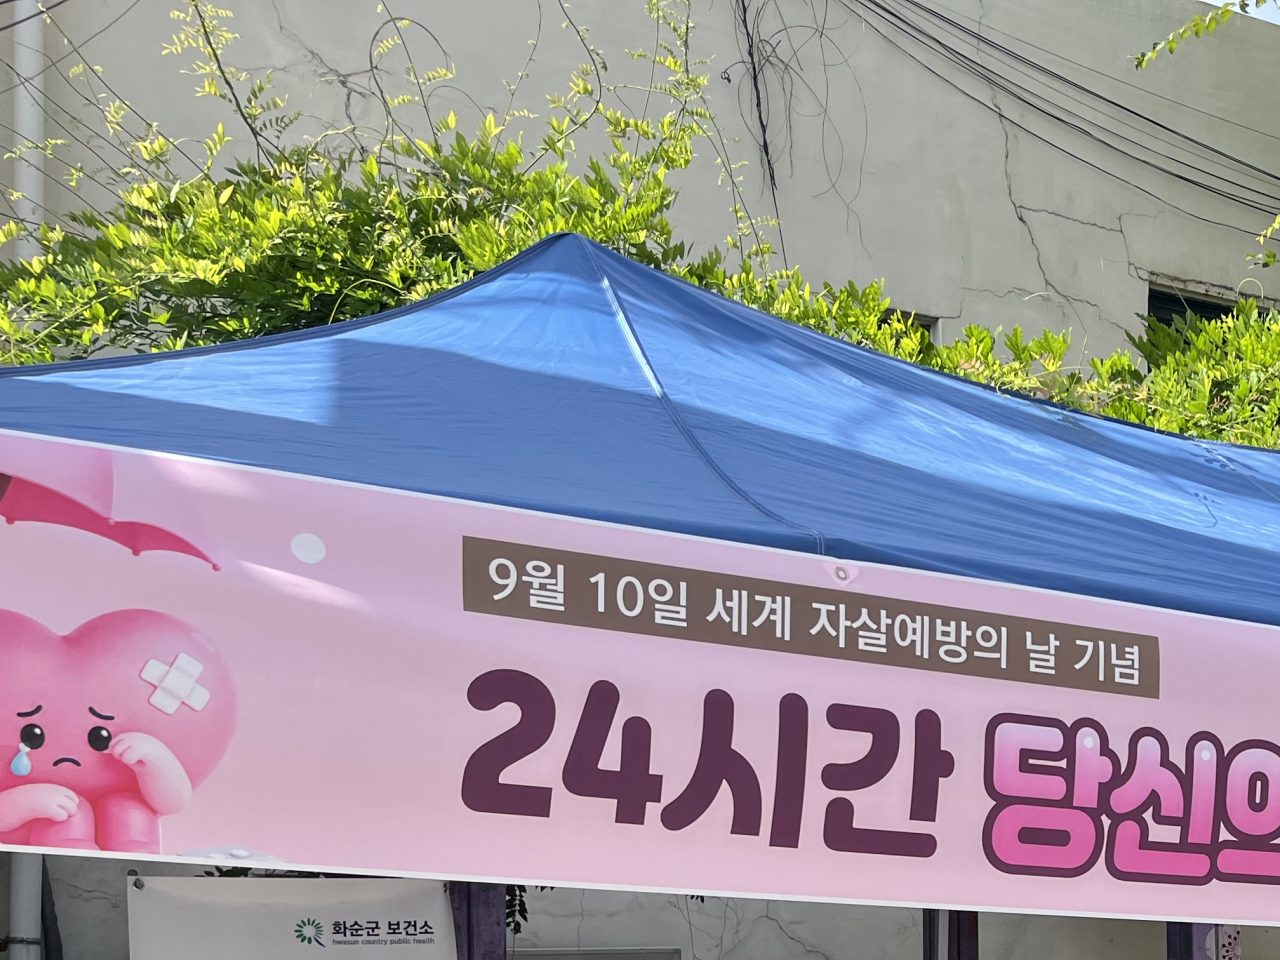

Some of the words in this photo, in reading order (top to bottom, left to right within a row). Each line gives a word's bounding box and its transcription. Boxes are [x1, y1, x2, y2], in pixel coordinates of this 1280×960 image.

[488, 556, 567, 612] 9월
[588, 570, 689, 628] 10일
[705, 587, 792, 642] 세계
[809, 600, 1009, 670] 자살예방의
[1025, 629, 1060, 673] 날
[1072, 637, 1142, 687] 기념
[461, 667, 956, 859] 24시간
[332, 920, 381, 937] 화순군
[386, 919, 435, 937] 보건소
[389, 937, 411, 946] public
